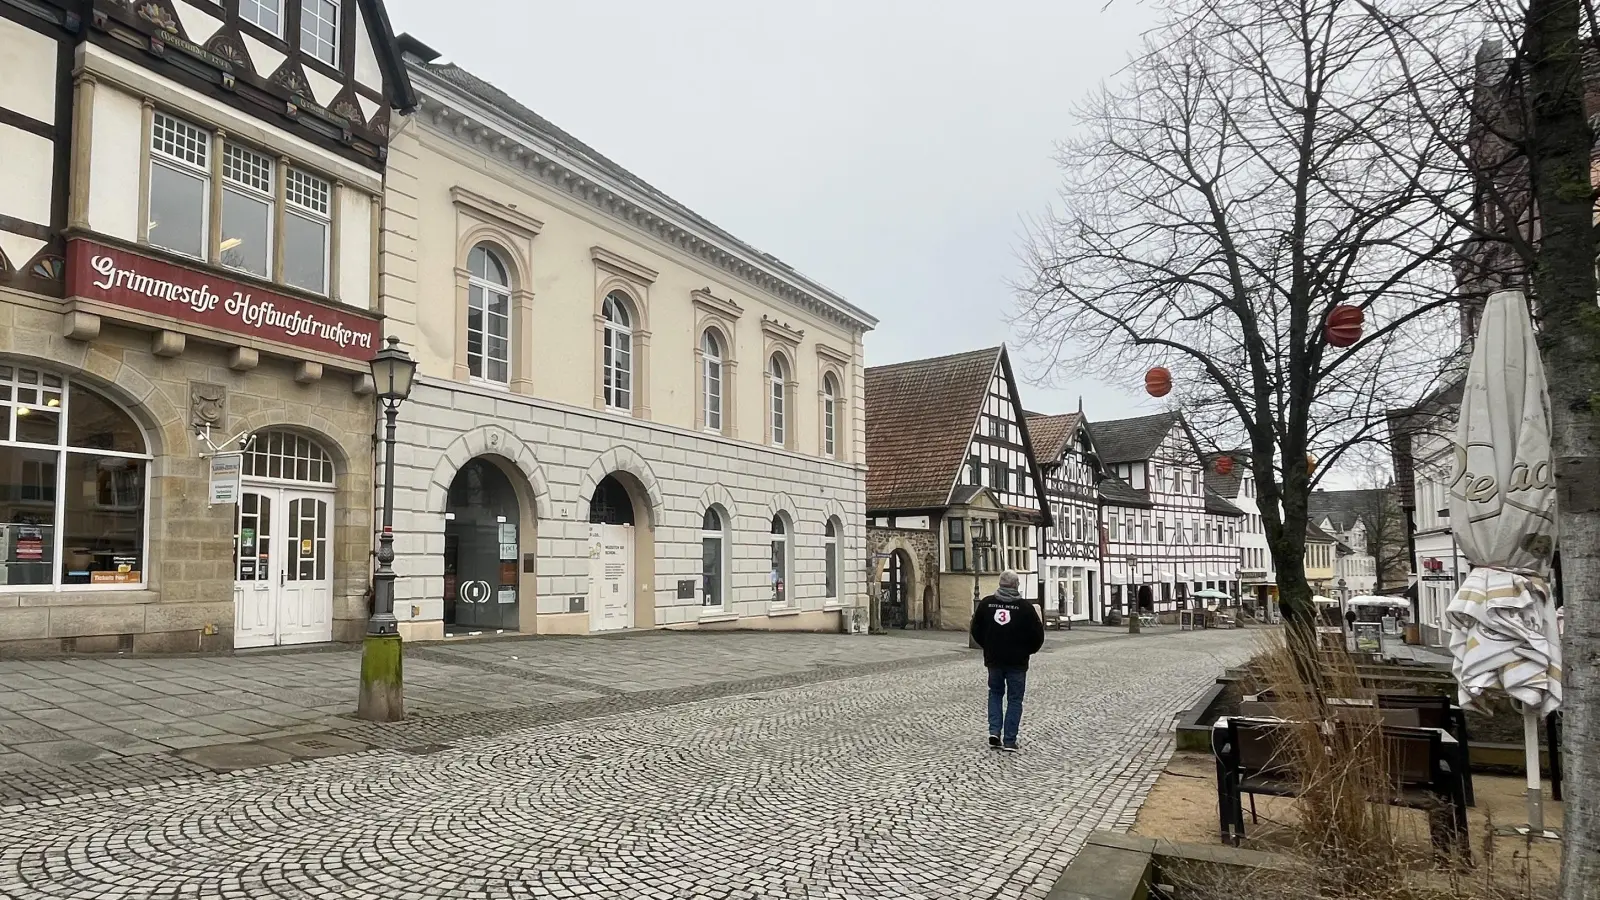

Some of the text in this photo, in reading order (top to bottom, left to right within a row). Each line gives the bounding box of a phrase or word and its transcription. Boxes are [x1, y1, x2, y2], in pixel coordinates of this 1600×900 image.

[91, 255, 372, 349] Grimmesche Hofbuchdruckerei
[998, 611, 1006, 623] 3
